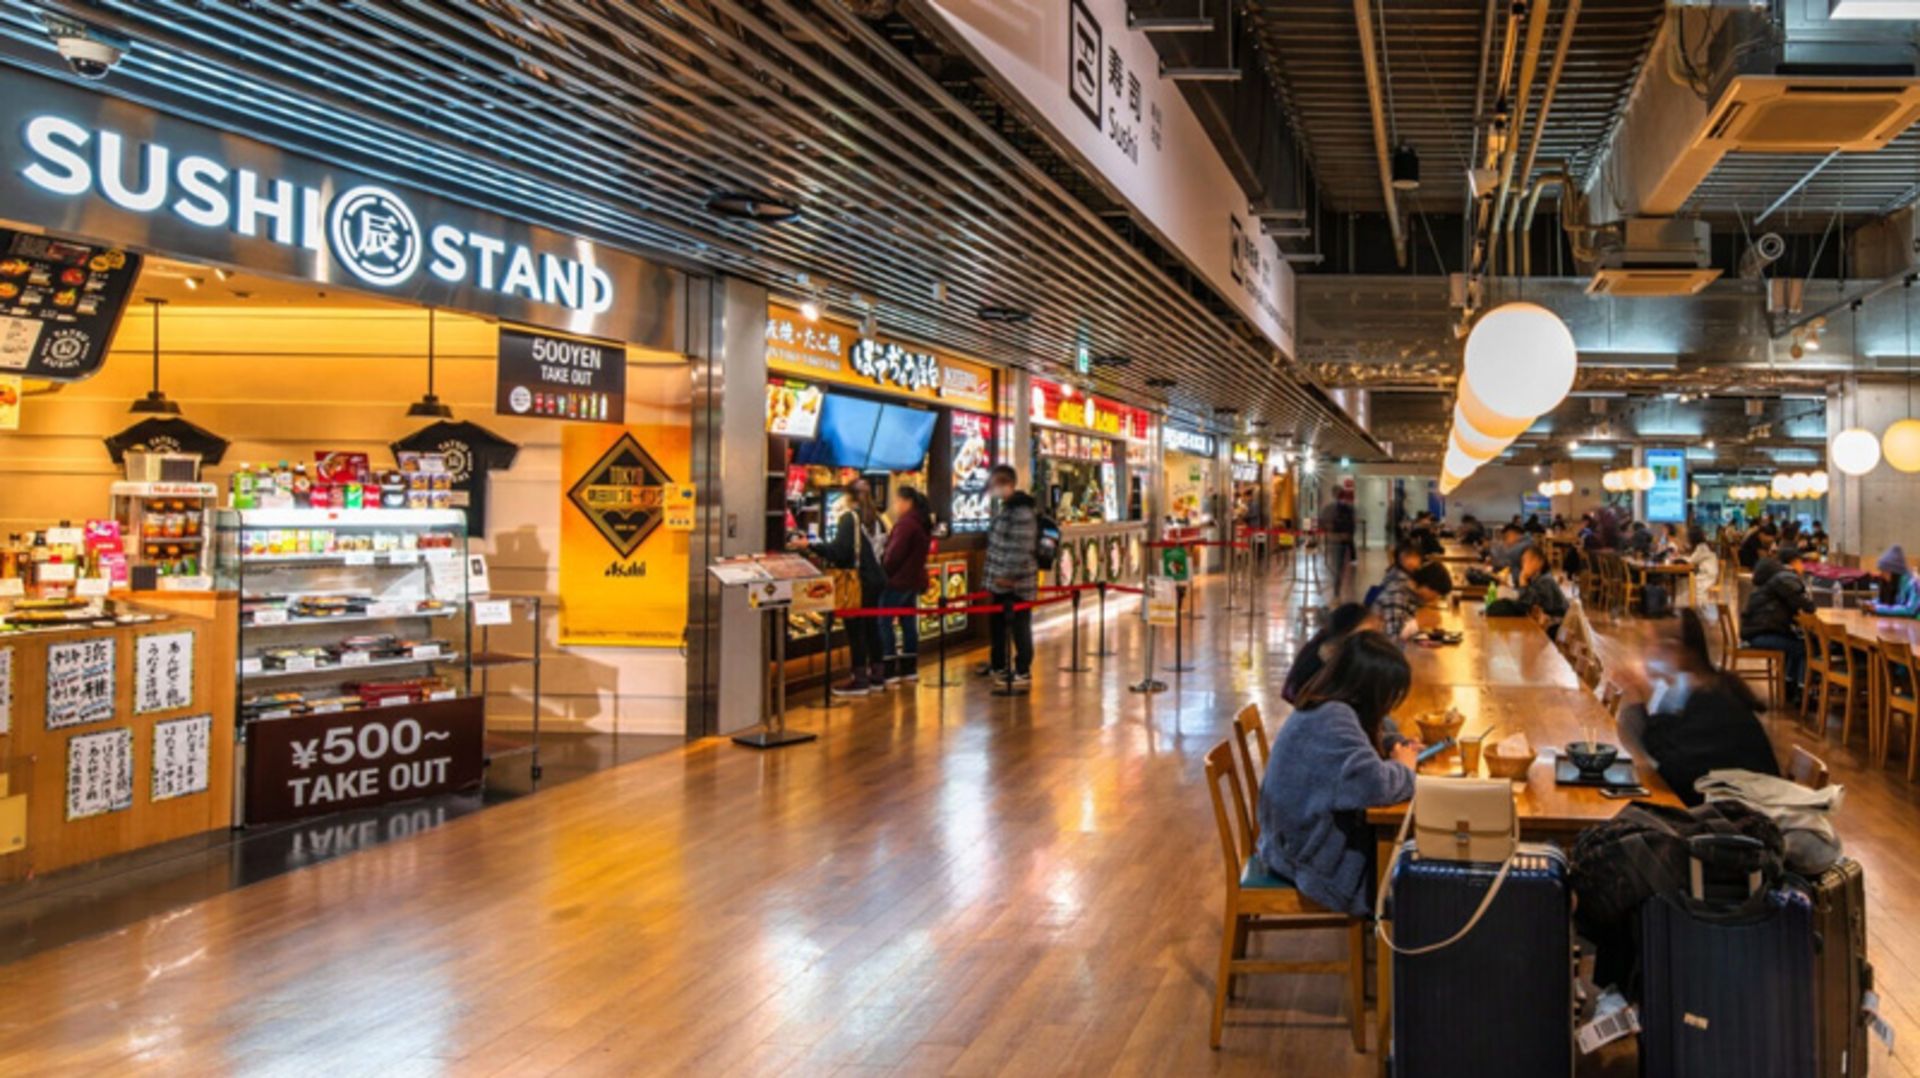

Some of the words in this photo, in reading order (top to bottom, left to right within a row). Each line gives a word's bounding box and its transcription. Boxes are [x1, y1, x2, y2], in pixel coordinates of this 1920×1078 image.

[1108, 106, 1139, 165] Sushi
[22, 116, 320, 251] SUSHI
[357, 209, 400, 261] 辰
[430, 224, 613, 315] STAND
[532, 337, 602, 370] 500YEN
[541, 364, 570, 383] TAKE
[570, 369, 593, 386] OUT
[605, 561, 646, 577] Asahi
[287, 767, 380, 807] TAKE
[389, 757, 452, 791] OUT
